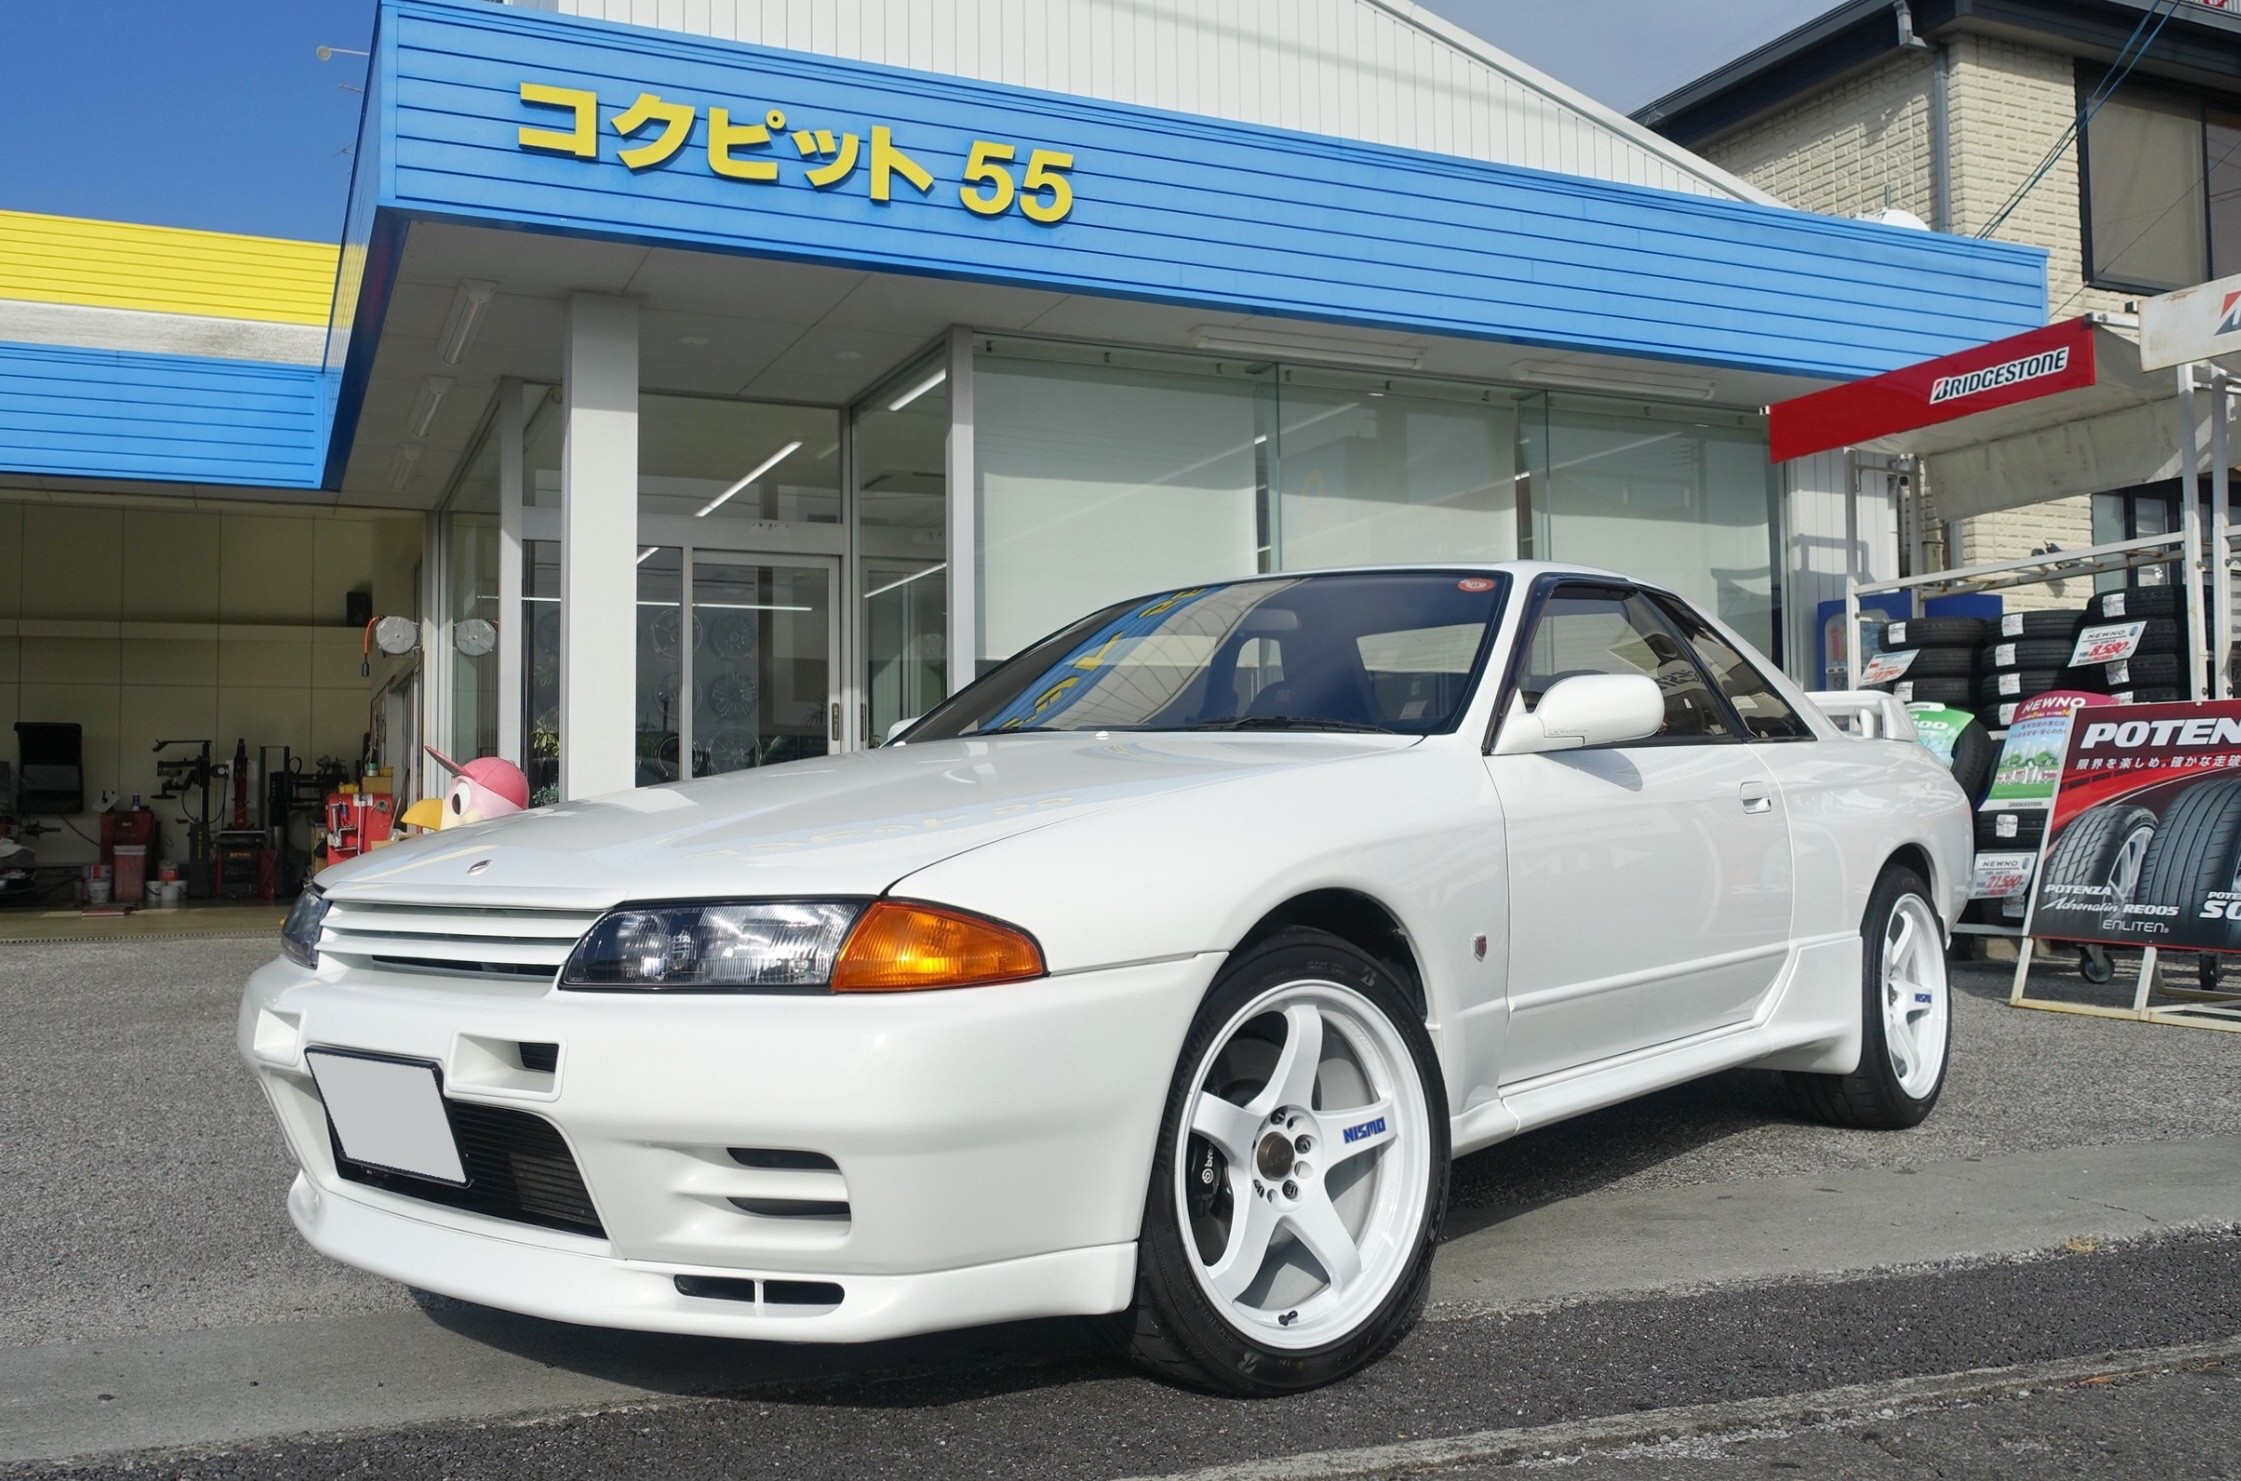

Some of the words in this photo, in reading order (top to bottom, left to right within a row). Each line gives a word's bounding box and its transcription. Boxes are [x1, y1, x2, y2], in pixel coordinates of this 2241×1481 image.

[518, 82, 934, 202] コクピット
[959, 140, 1074, 223] 55
[1931, 348, 2068, 402] BRIDGESTONE
[2088, 629, 2126, 639] NEWNO
[2021, 696, 2086, 714] NEWNO
[2080, 717, 2241, 749] POTEN
[2044, 884, 2112, 896] POTENZA
[2040, 896, 2119, 912] Adrenalin
[2122, 904, 2180, 916] RE005
[1343, 1116, 1386, 1144] NISMO
